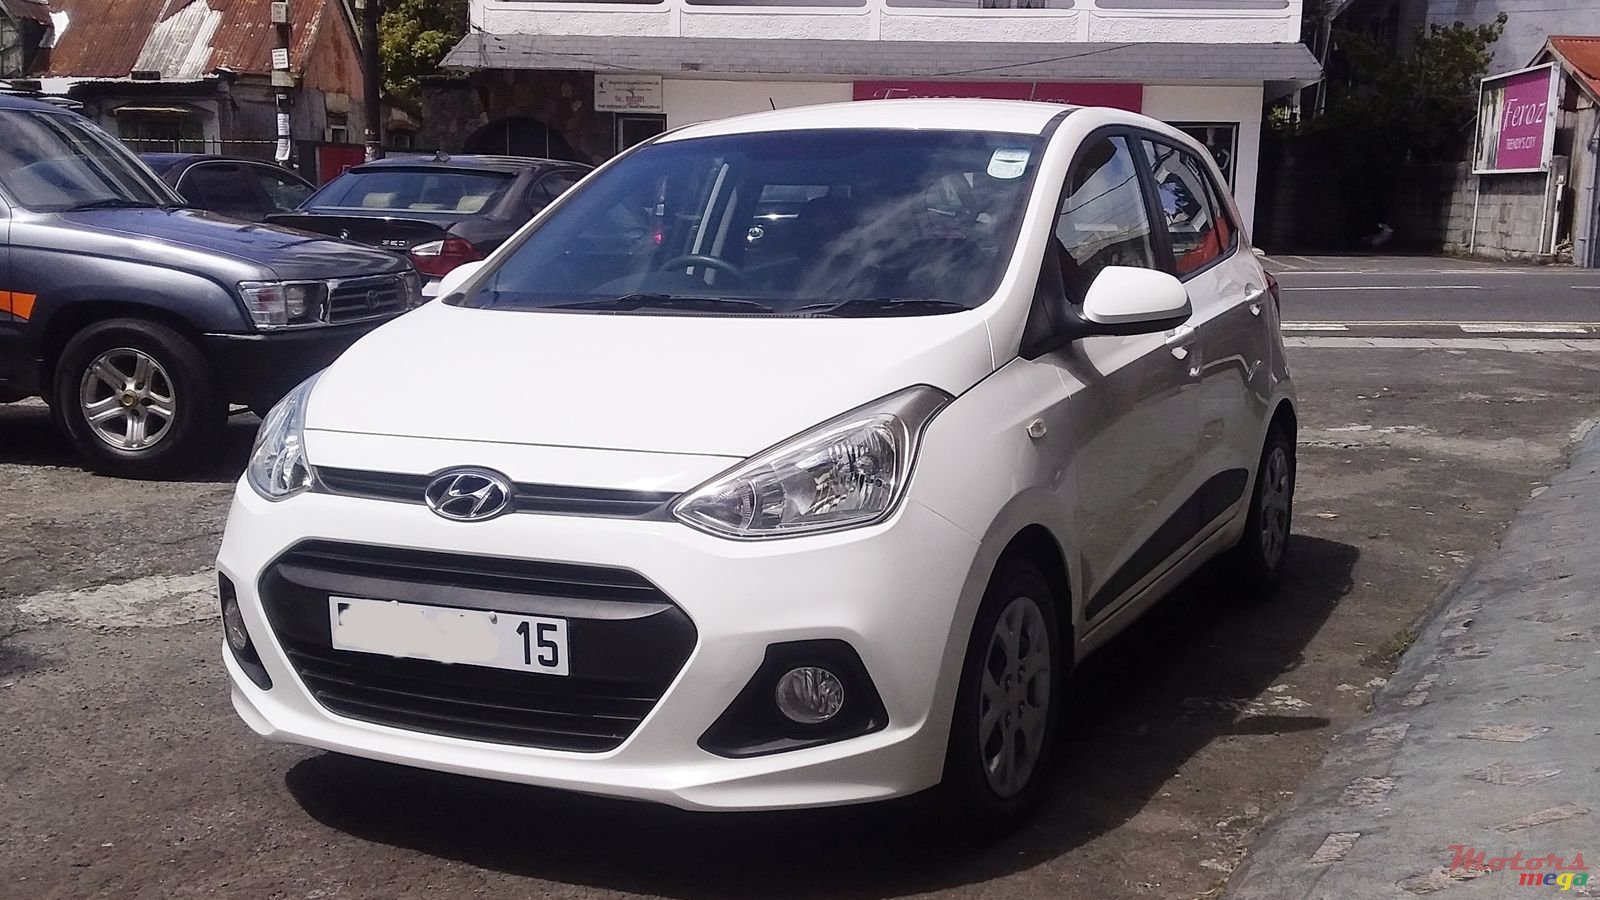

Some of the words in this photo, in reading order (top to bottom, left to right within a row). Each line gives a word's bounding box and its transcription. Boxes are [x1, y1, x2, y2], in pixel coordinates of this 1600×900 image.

[1502, 98, 1546, 131] Feroz
[1525, 136, 1536, 148] CITY
[516, 621, 558, 667] 15
